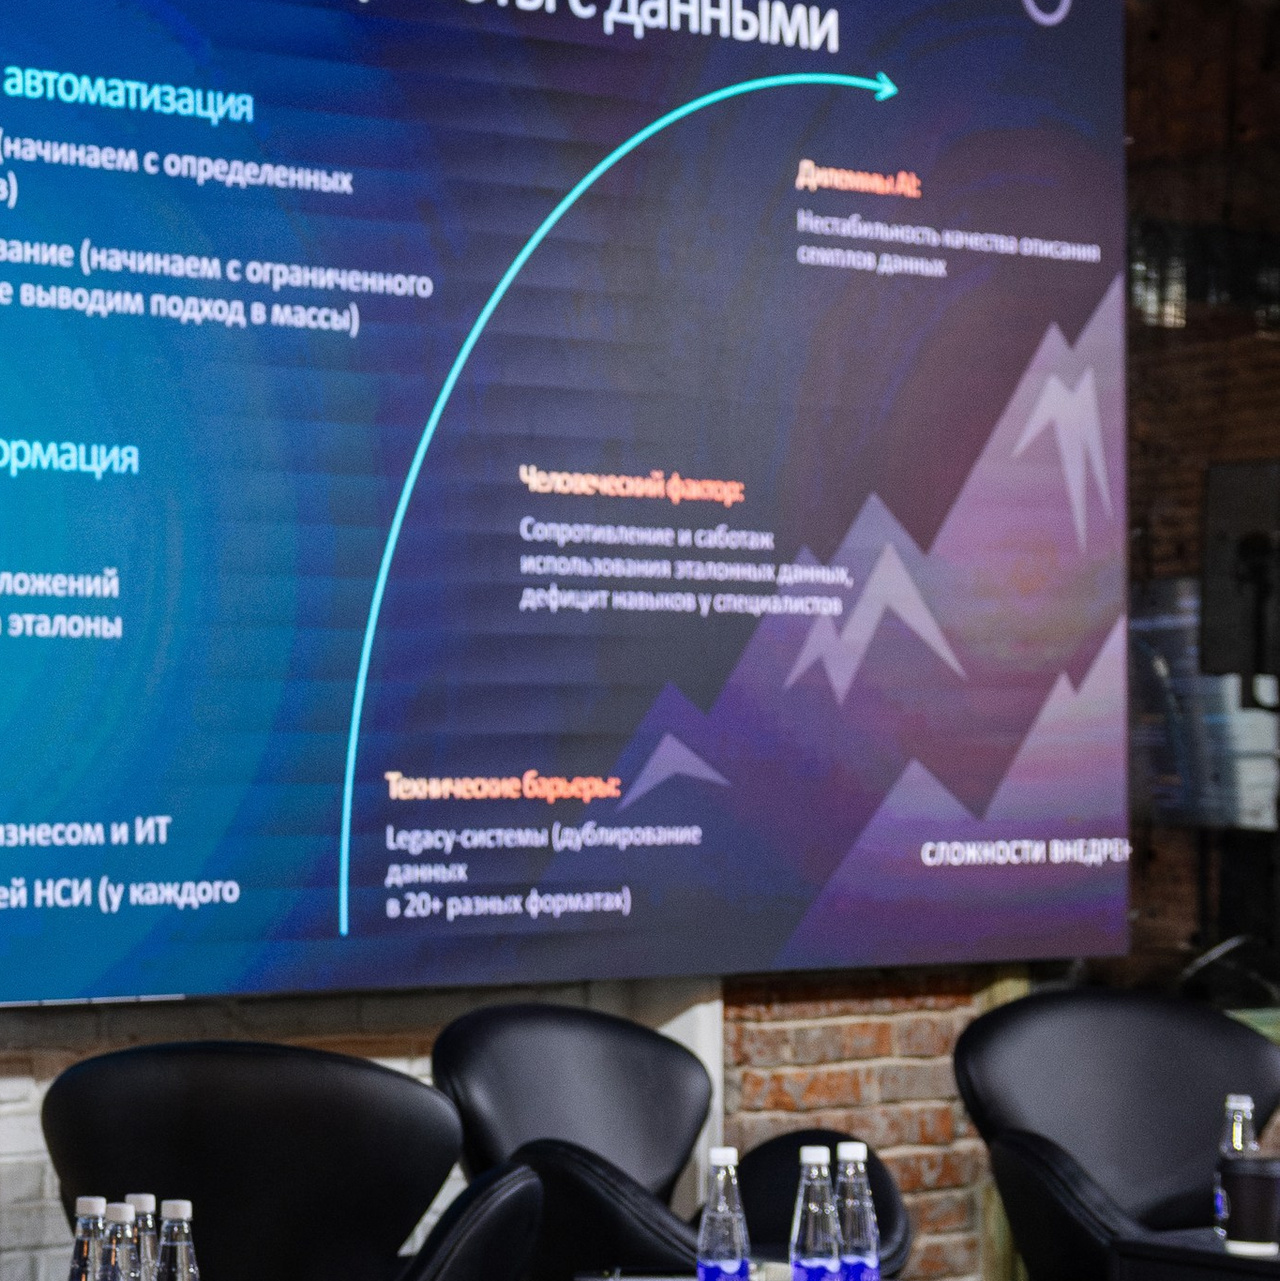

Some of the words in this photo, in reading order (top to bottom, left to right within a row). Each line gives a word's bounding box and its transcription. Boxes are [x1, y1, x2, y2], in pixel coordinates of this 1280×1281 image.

[2, 64, 254, 124] автоматизация
[143, 151, 159, 173] с
[163, 154, 353, 195] определенных
[80, 238, 221, 280] (начинаем
[226, 259, 242, 282] с
[246, 260, 433, 299] ограниченного
[19, 281, 144, 317] выводим
[150, 292, 245, 328] подход
[250, 302, 265, 325] в
[270, 302, 359, 338] массы)
[519, 516, 674, 548] Сопротивление
[677, 528, 692, 547] и
[519, 583, 609, 613] дефицит
[698, 594, 711, 617] у
[7, 612, 122, 639] эталоны
[110, 822, 128, 845] и
[135, 815, 171, 844] ИТ
[386, 824, 549, 855] Legacy-системы
[34, 877, 92, 908] НСИ
[98, 876, 124, 912] (у
[129, 879, 239, 909] каждого
[386, 898, 401, 918] в
[404, 891, 443, 918] 20+
[446, 894, 523, 921] разных
